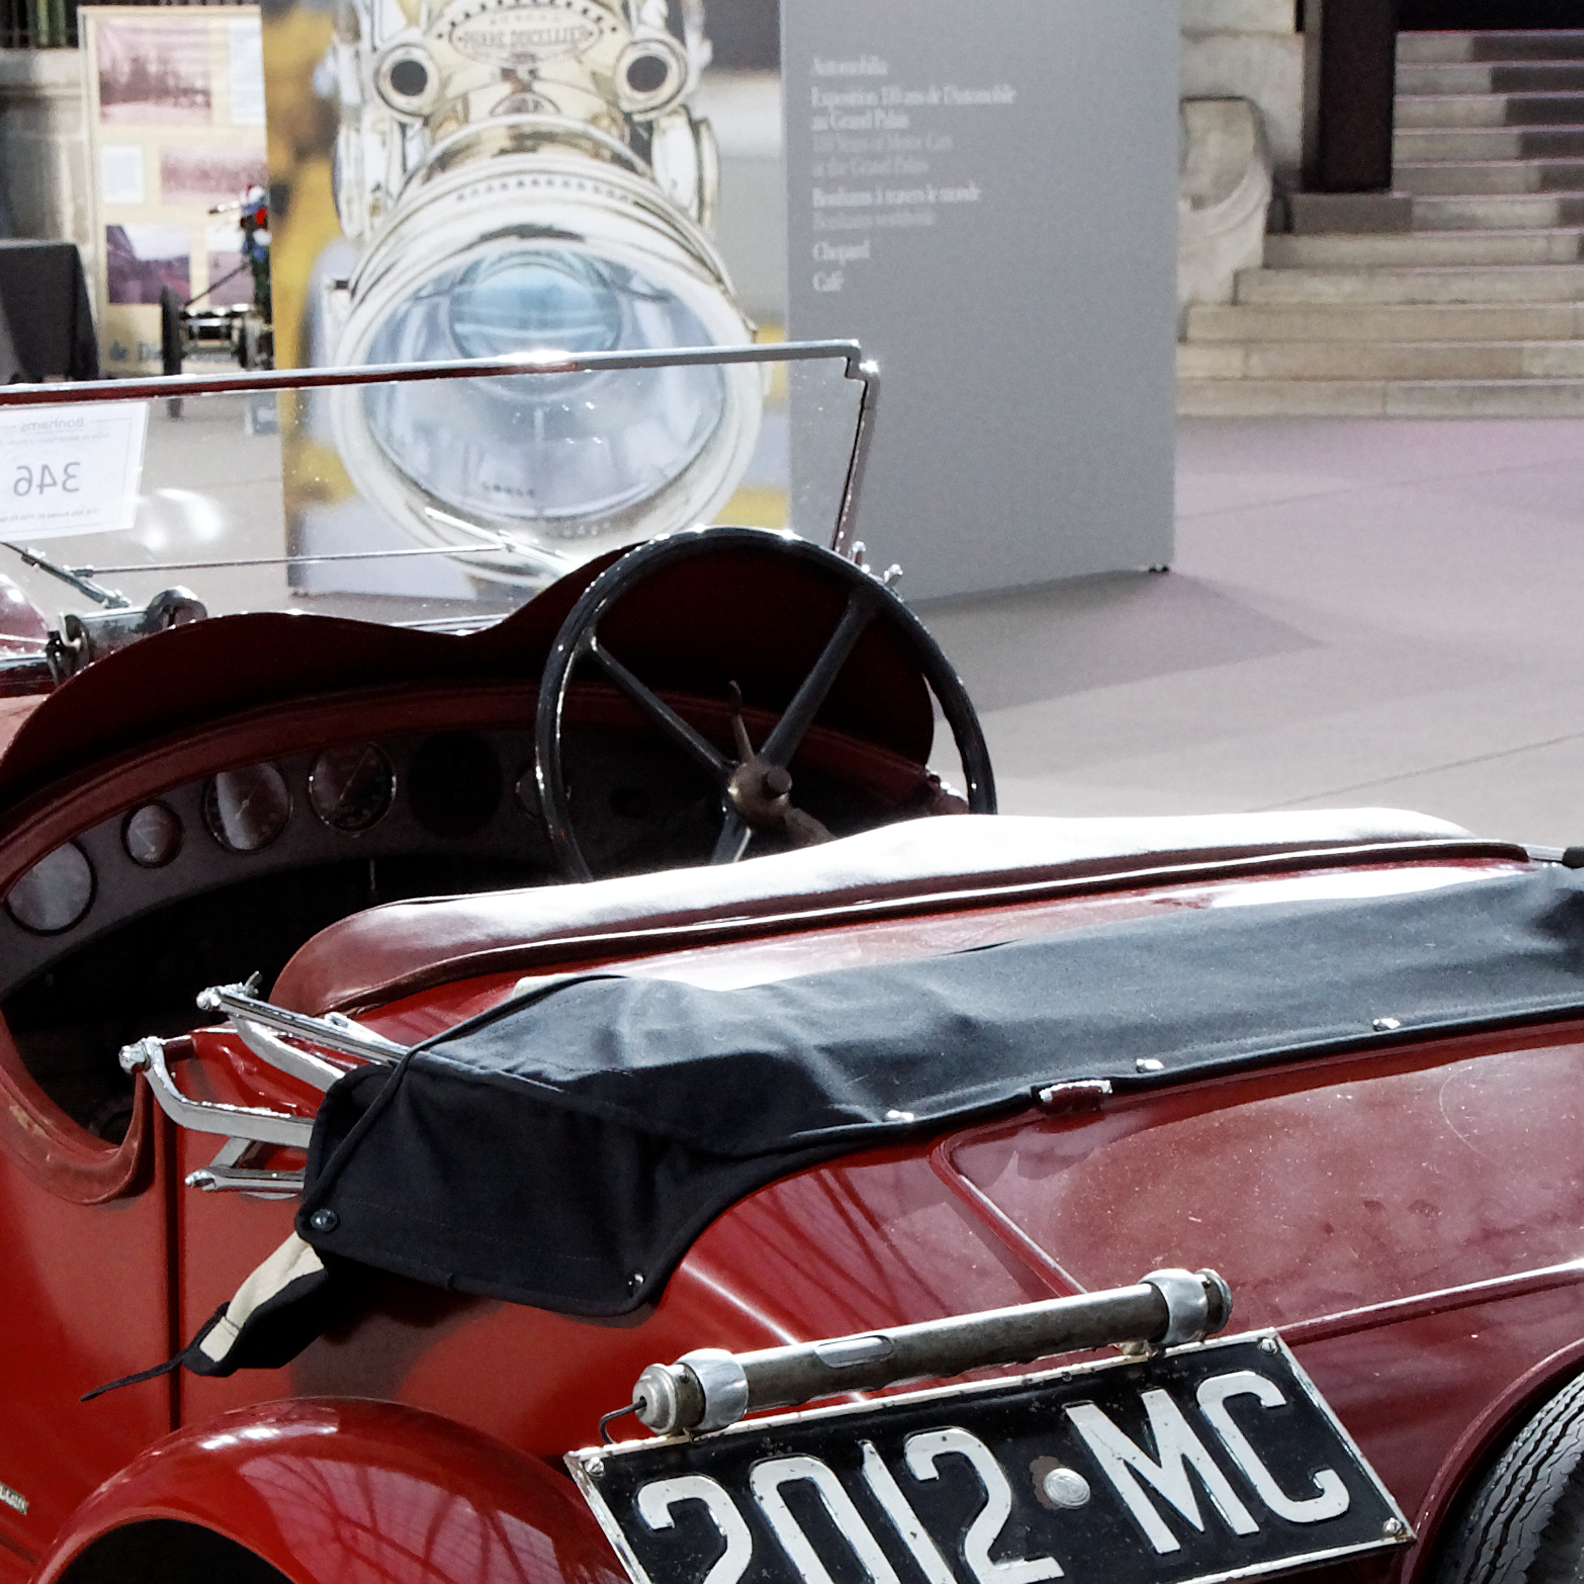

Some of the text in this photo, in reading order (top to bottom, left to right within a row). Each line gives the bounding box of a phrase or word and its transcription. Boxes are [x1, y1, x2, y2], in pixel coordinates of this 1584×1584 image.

[830, 109, 872, 131] Grand
[874, 109, 910, 130] Palais
[1063, 1369, 1352, 1555] MC
